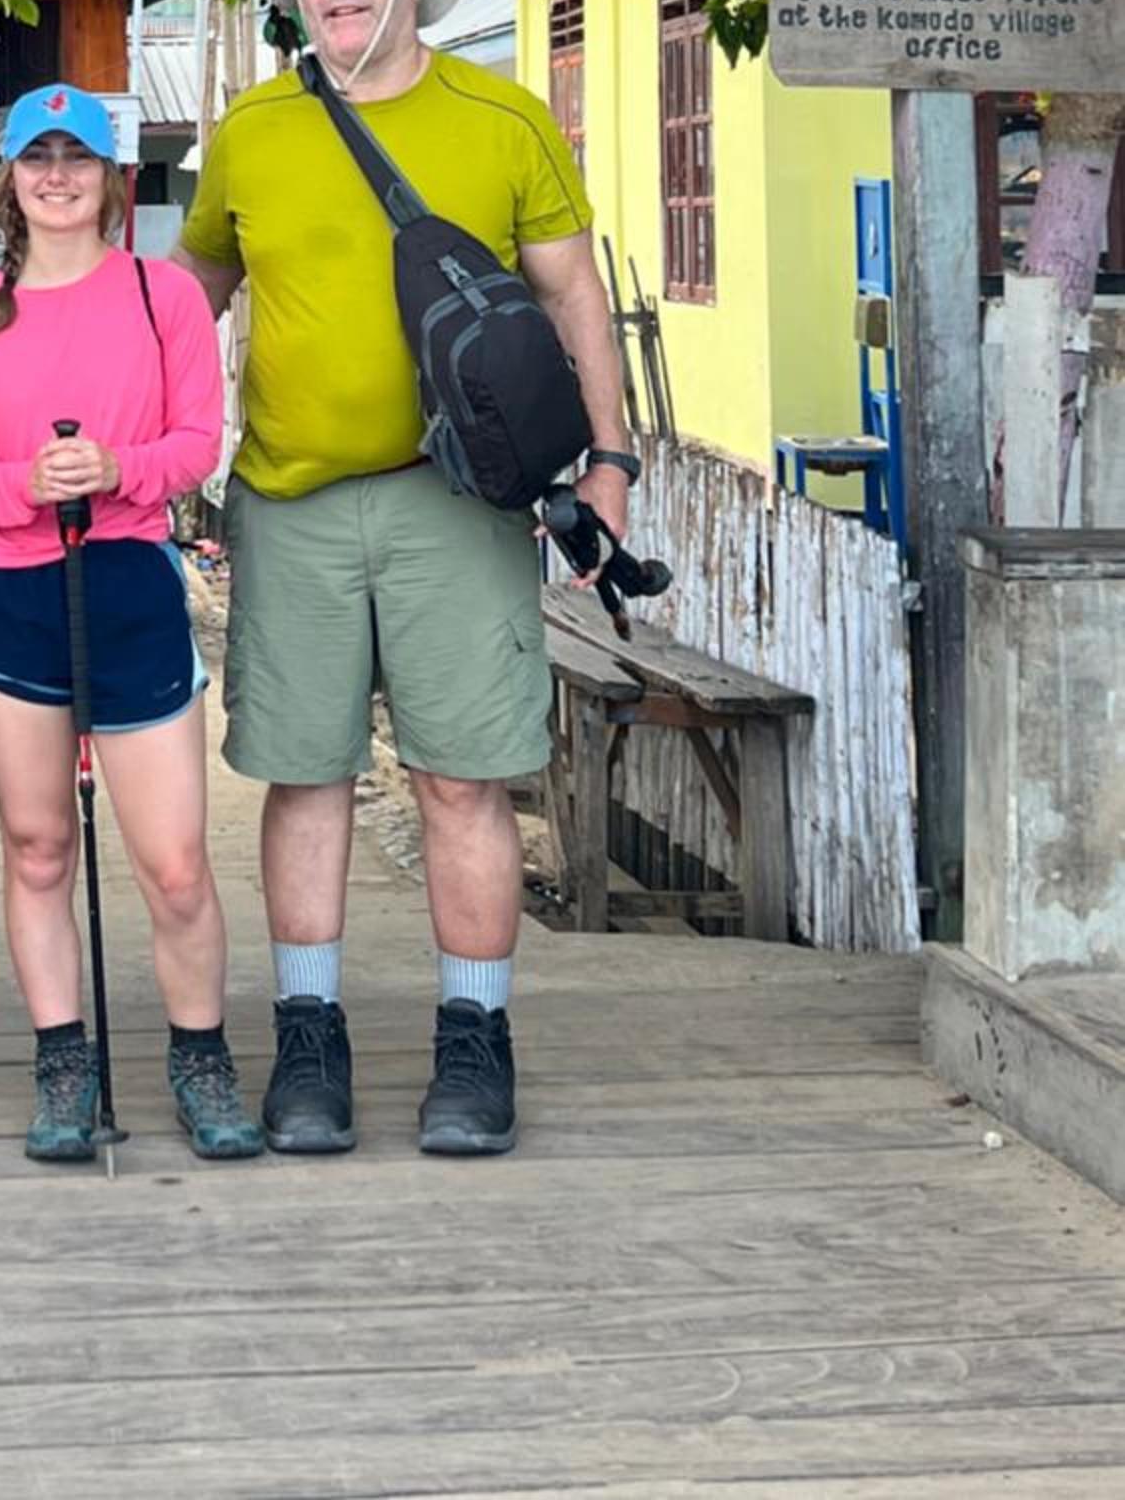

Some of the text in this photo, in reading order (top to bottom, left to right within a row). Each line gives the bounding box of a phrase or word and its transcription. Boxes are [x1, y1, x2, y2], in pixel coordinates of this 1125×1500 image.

[778, 4, 810, 27] at
[819, 5, 867, 29] the
[988, 9, 1077, 37] village
[906, 34, 1002, 61] office
